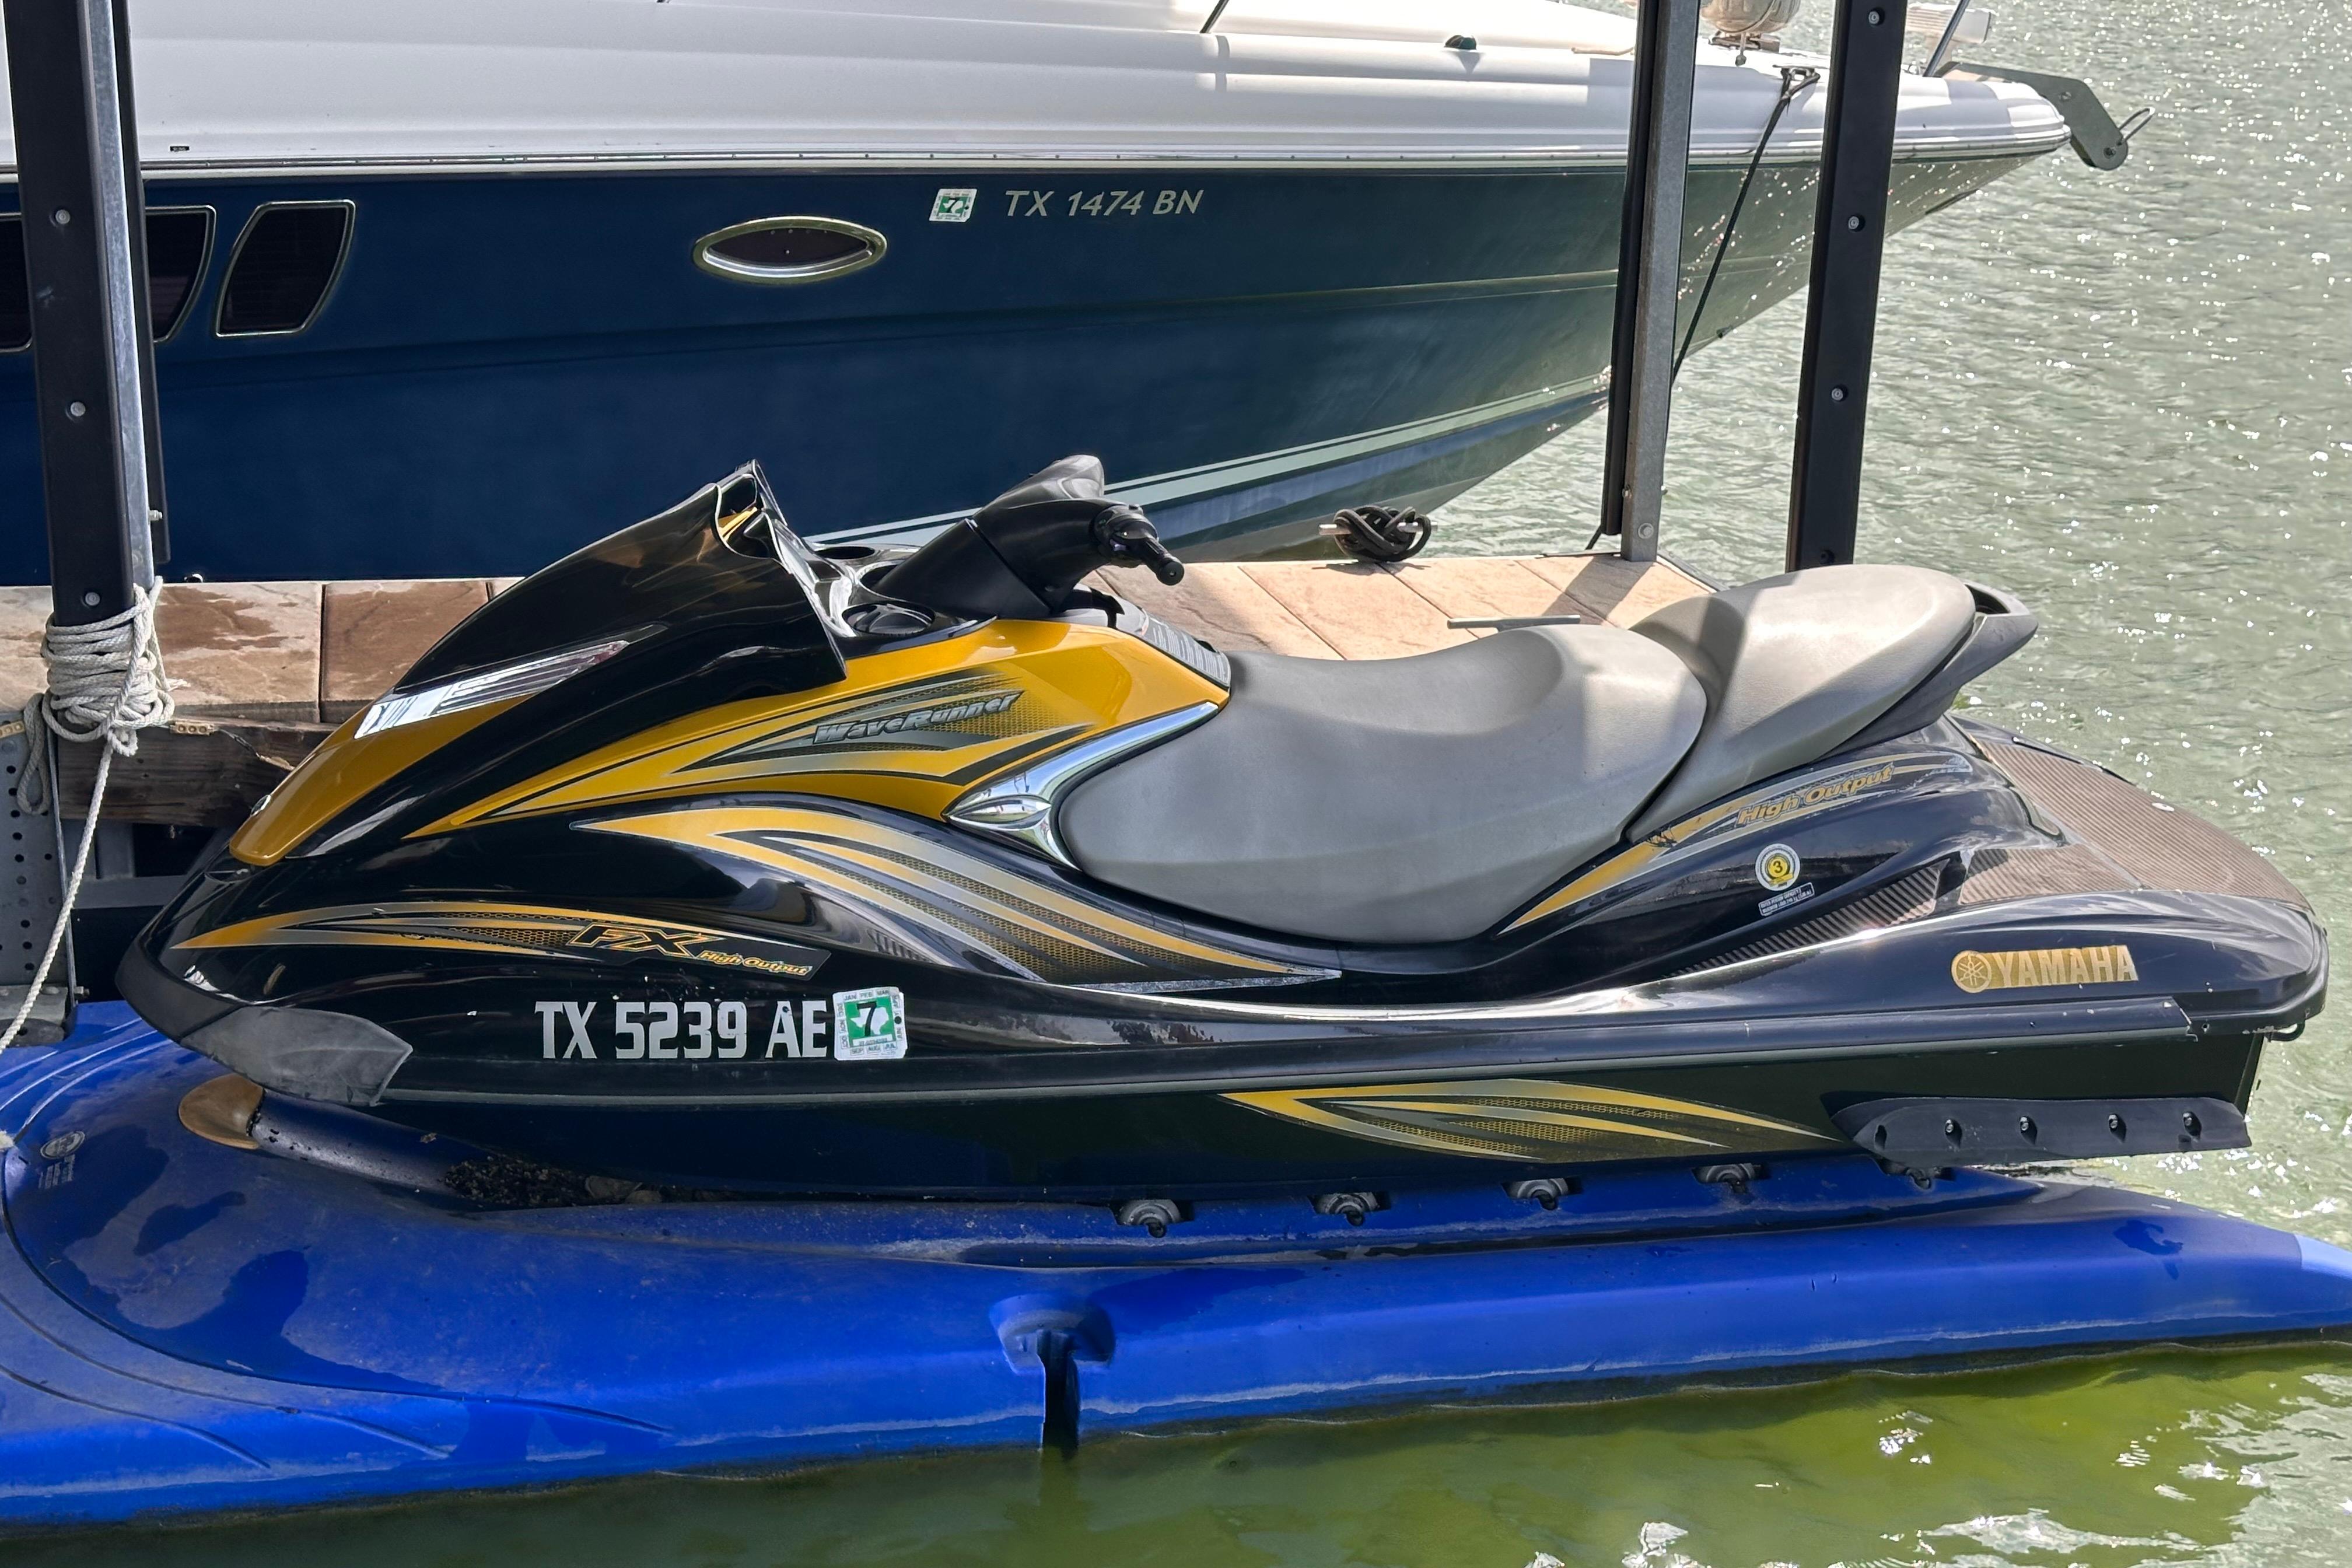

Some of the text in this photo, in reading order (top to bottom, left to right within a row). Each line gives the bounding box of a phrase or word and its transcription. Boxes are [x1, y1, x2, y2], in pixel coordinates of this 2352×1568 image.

[1005, 189, 1205, 216] TX 1474 BN
[814, 692, 1022, 743] WaveRunner
[1736, 762, 1894, 826] High Output
[1773, 860, 1783, 874] 3
[565, 922, 727, 958] FX
[697, 950, 813, 977] High Output
[1992, 945, 2138, 988] YAMAHA
[534, 1000, 827, 1059] TX 5239 AE
[856, 1001, 877, 1037] 7
